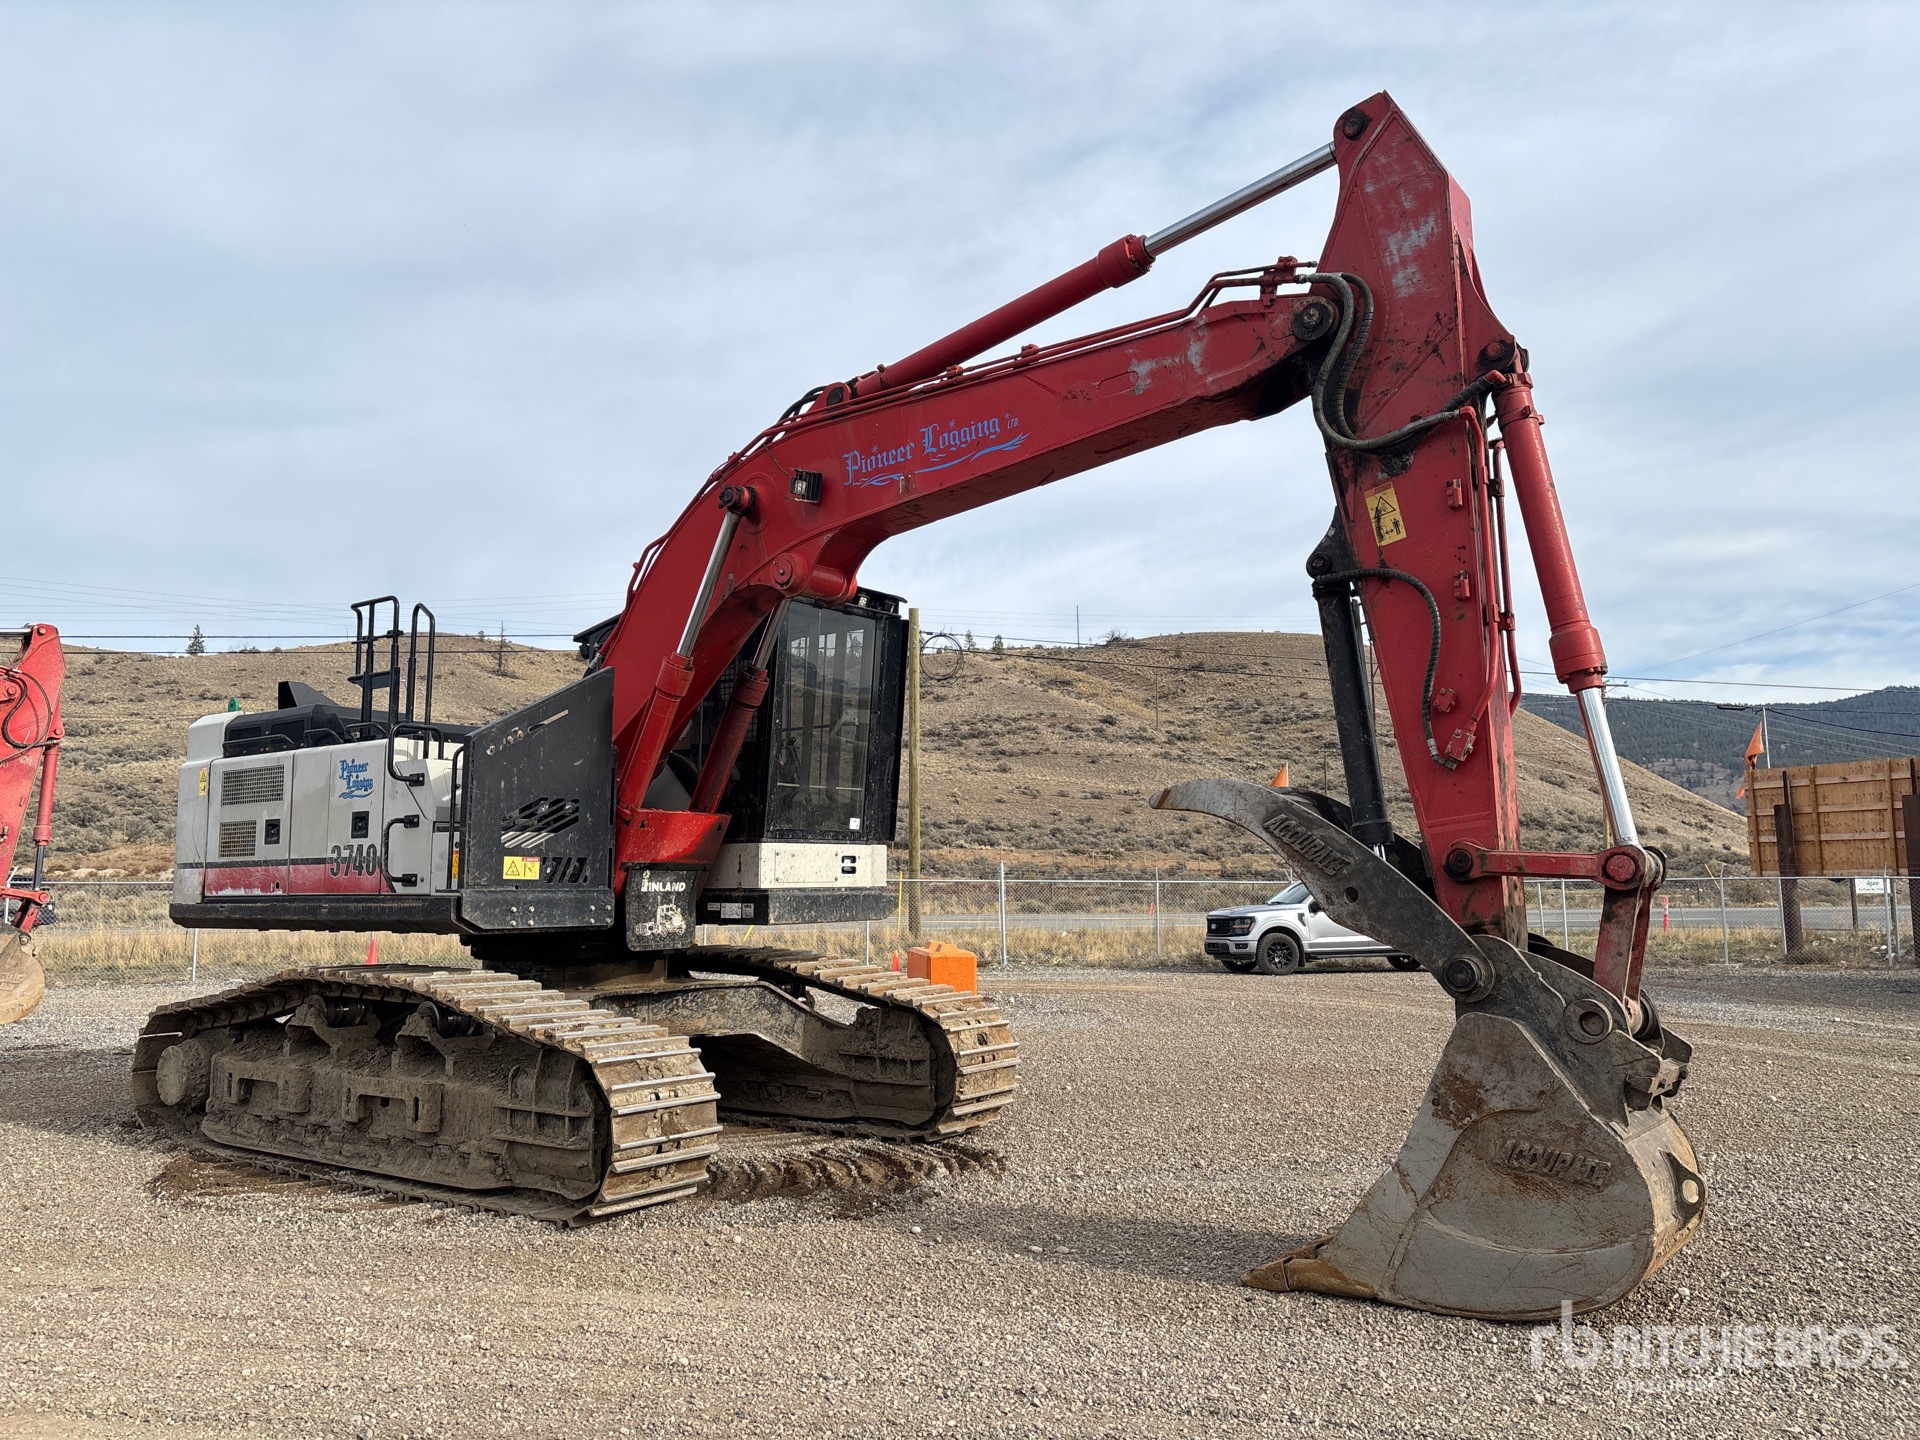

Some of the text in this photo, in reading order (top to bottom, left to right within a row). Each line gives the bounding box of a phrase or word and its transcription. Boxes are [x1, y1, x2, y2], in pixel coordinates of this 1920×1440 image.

[842, 441, 914, 486] Pioneer
[920, 417, 1001, 460] Logging
[330, 843, 378, 877] 3740
[1263, 814, 1351, 876] ACCURATE
